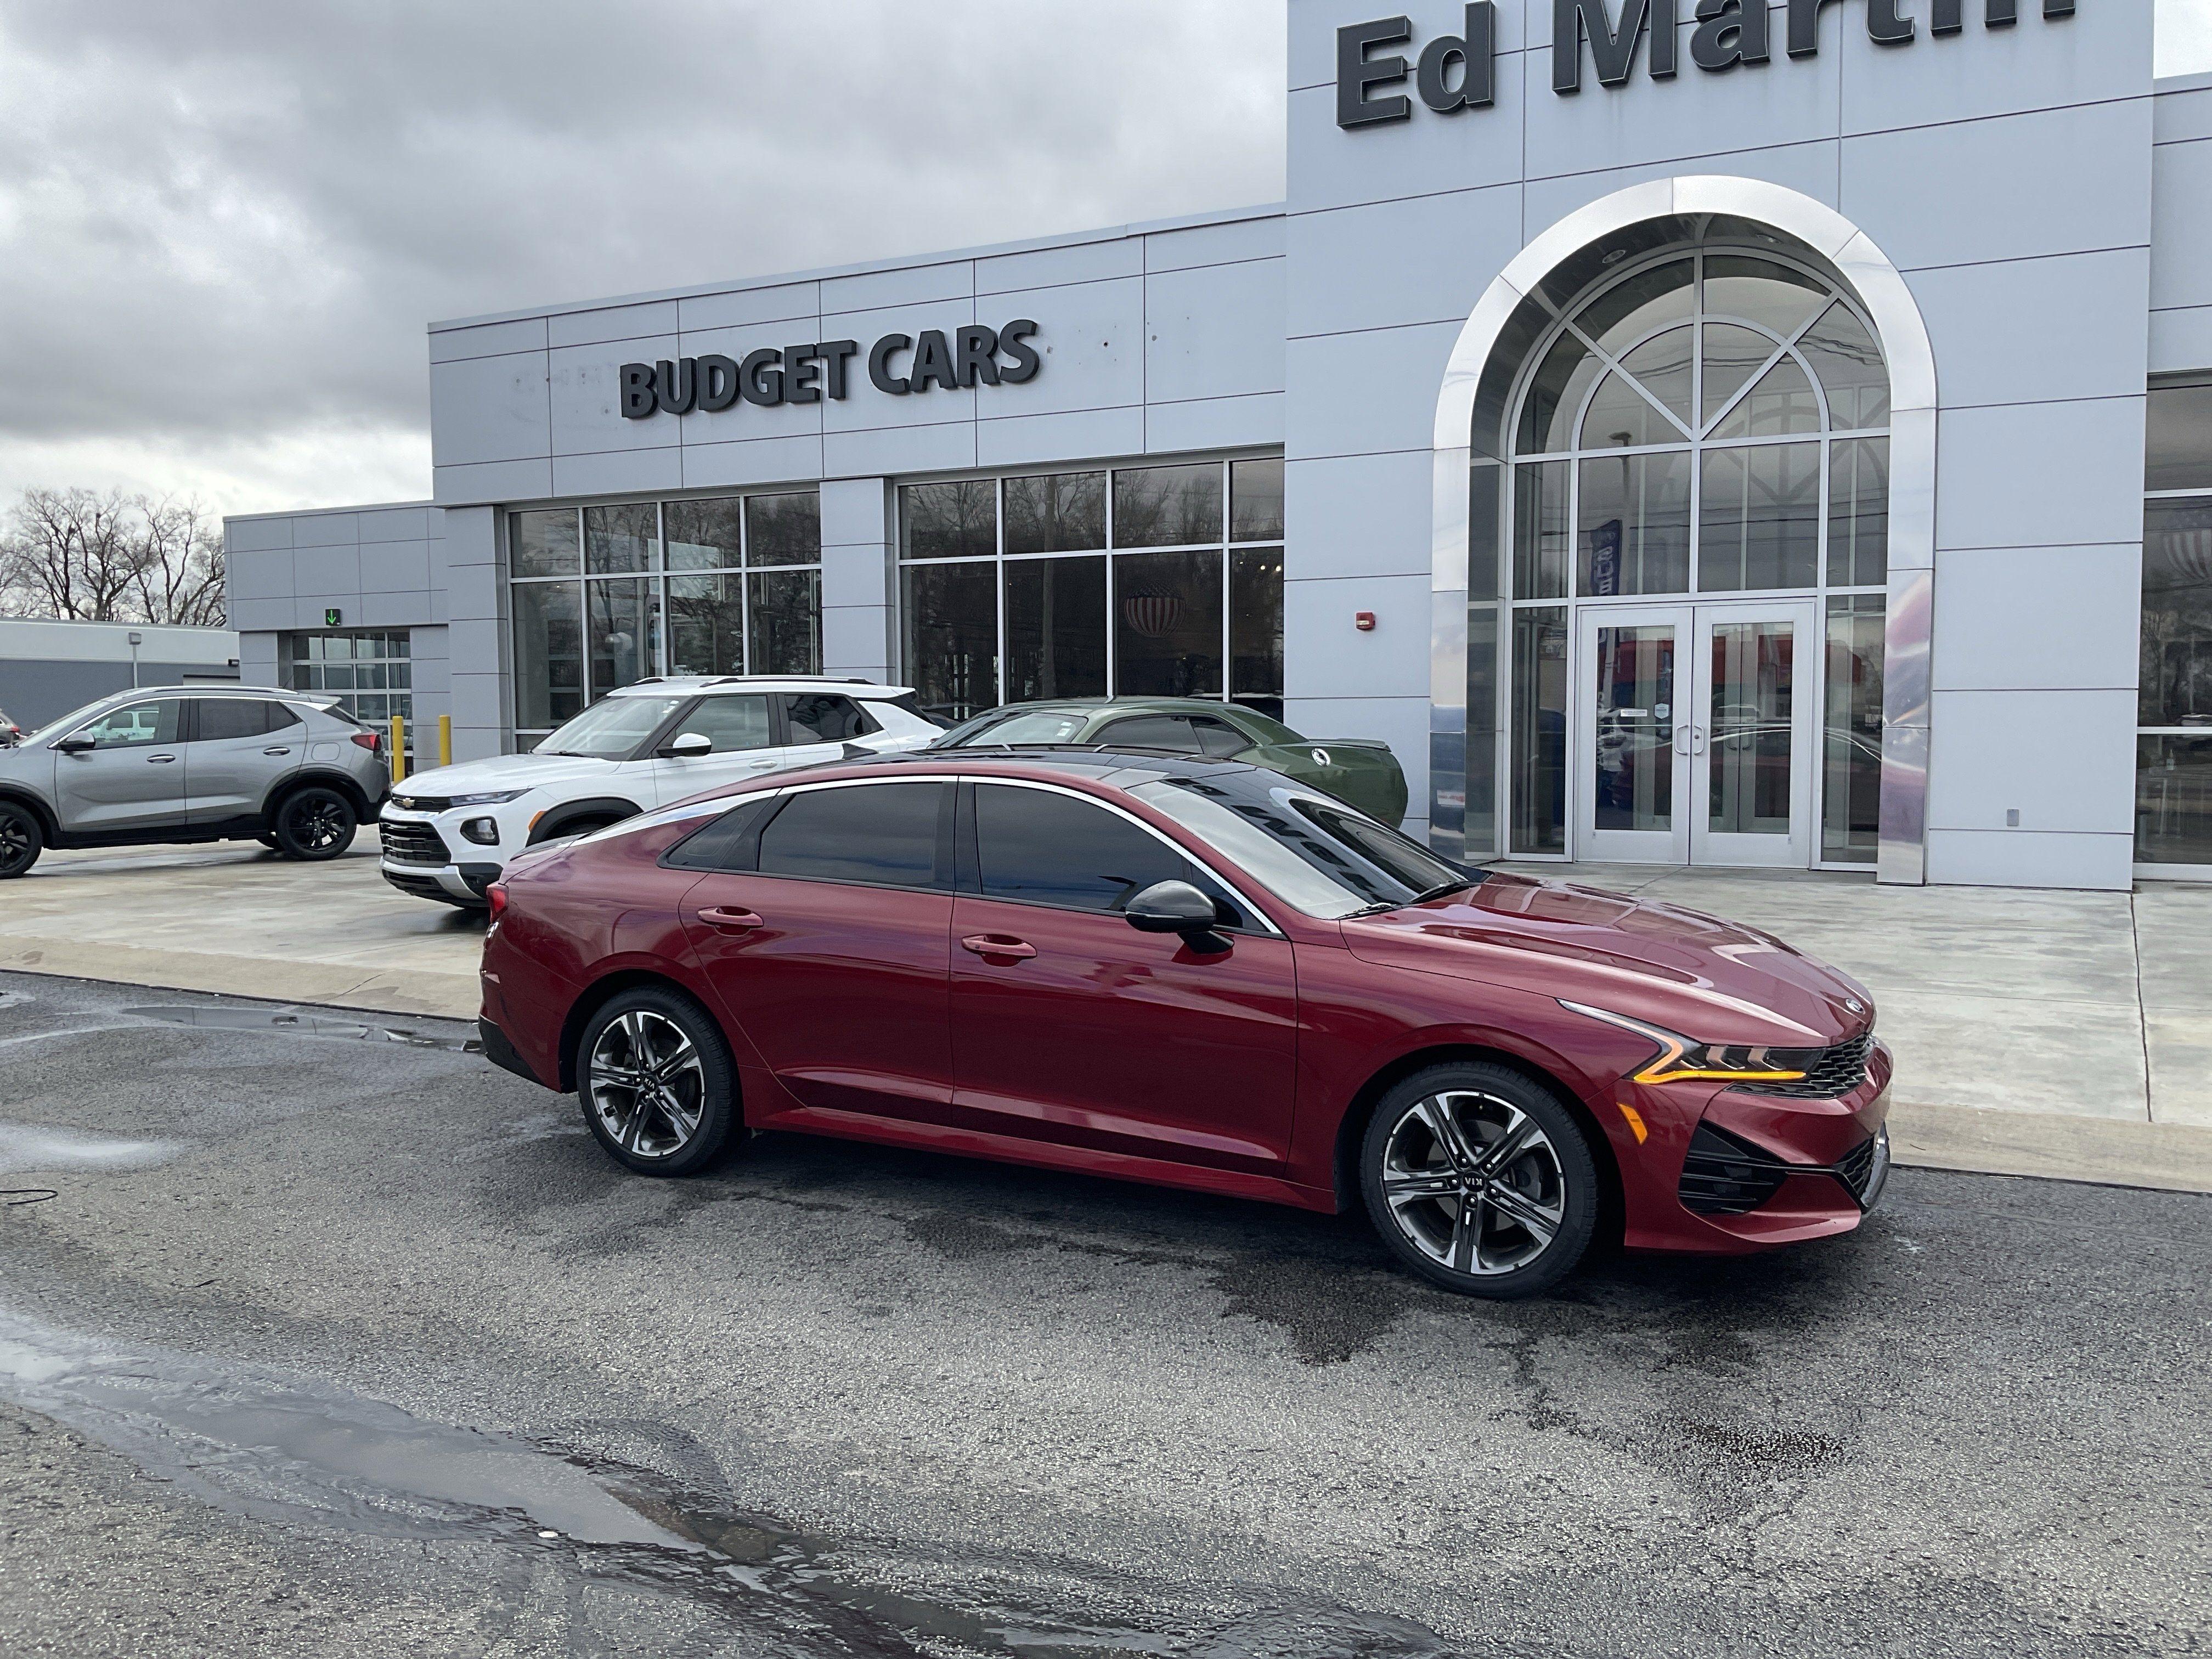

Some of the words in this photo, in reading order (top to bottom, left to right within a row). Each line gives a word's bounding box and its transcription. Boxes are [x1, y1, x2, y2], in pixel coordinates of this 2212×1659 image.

[1336, 0, 1496, 130] Ed
[1552, 0, 2075, 94] Mar
[619, 340, 857, 419] BUDGET
[868, 319, 1040, 394] CARS
[644, 1077, 655, 1089] KIA
[1464, 1177, 1483, 1186] KIA
